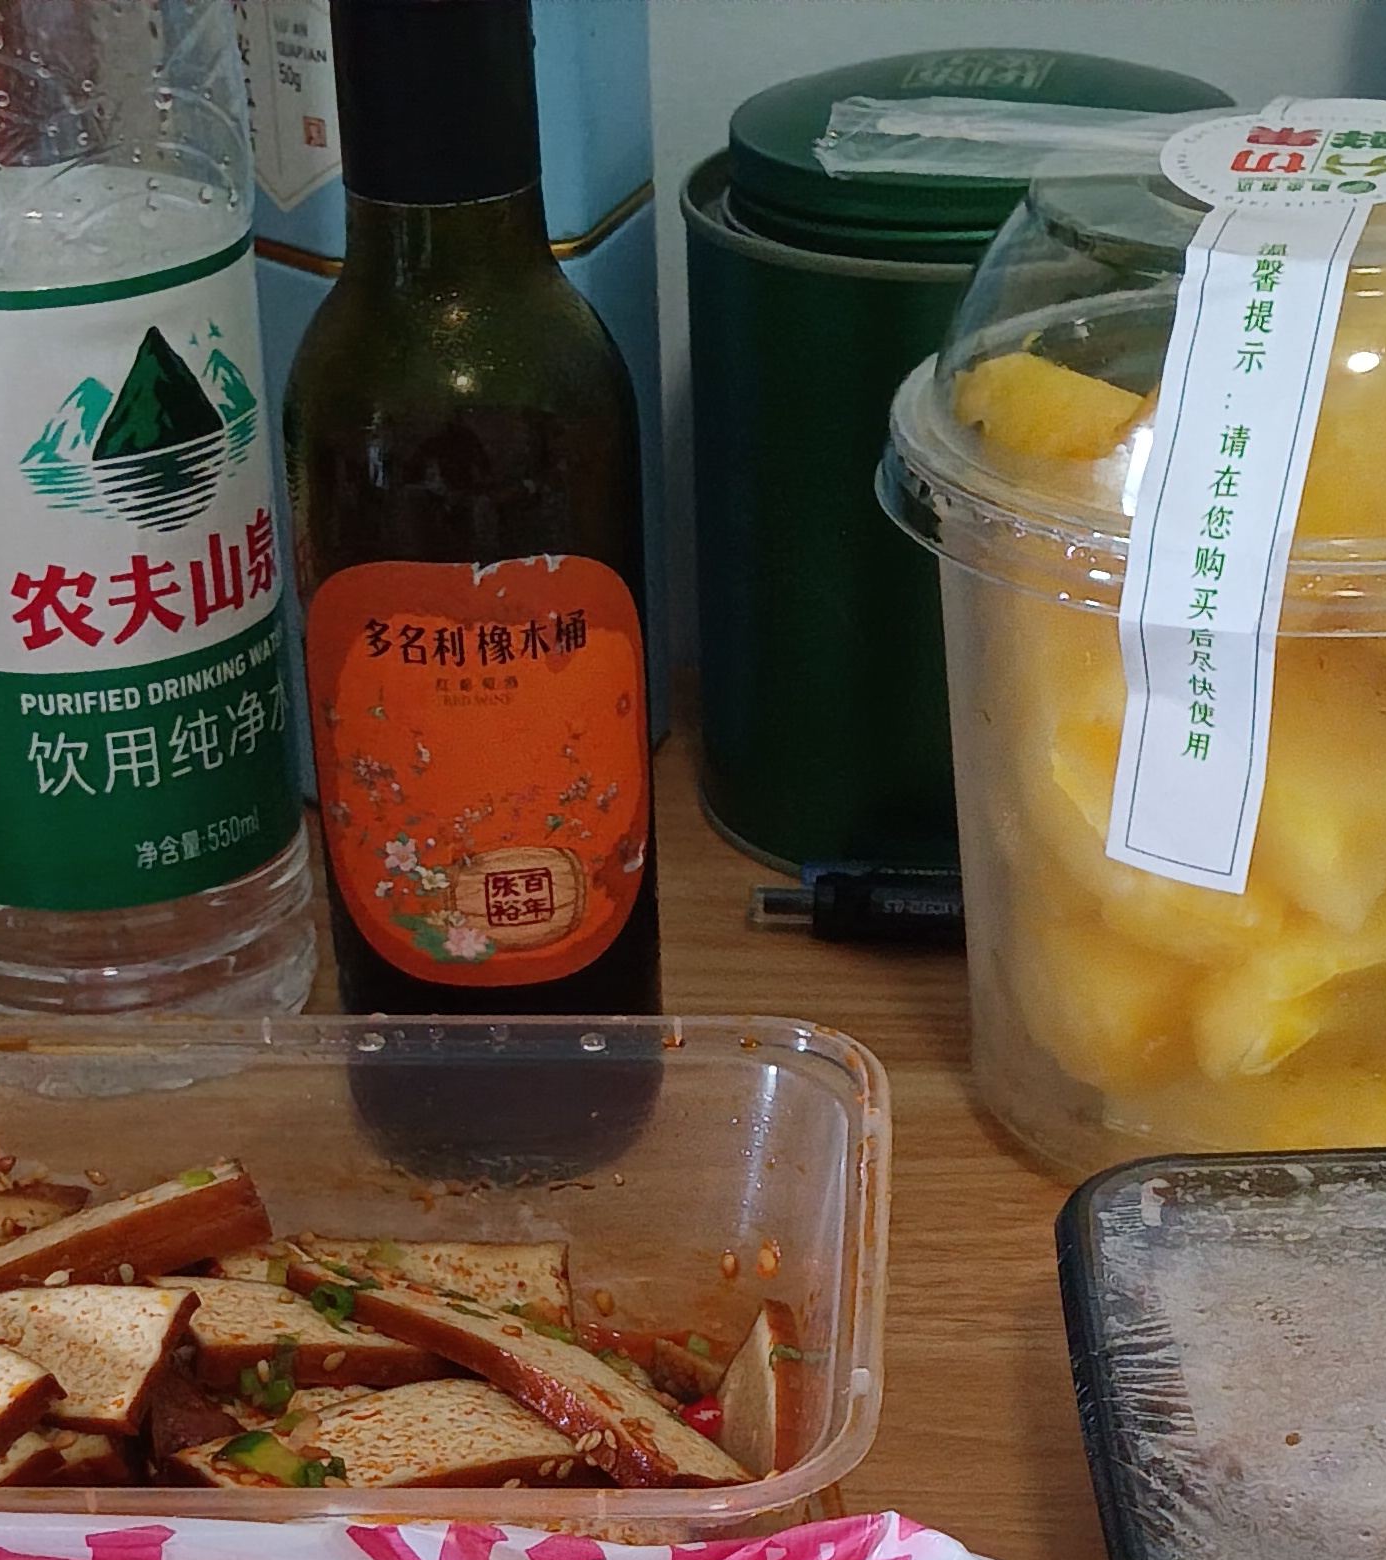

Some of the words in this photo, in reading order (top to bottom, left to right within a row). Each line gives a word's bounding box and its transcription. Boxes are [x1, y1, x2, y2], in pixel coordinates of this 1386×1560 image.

[9, 507, 277, 652] 农夫山泉
[364, 608, 587, 668] 多名利橡木桶
[19, 686, 142, 717] PURIFIED
[147, 652, 247, 707] DRINKING
